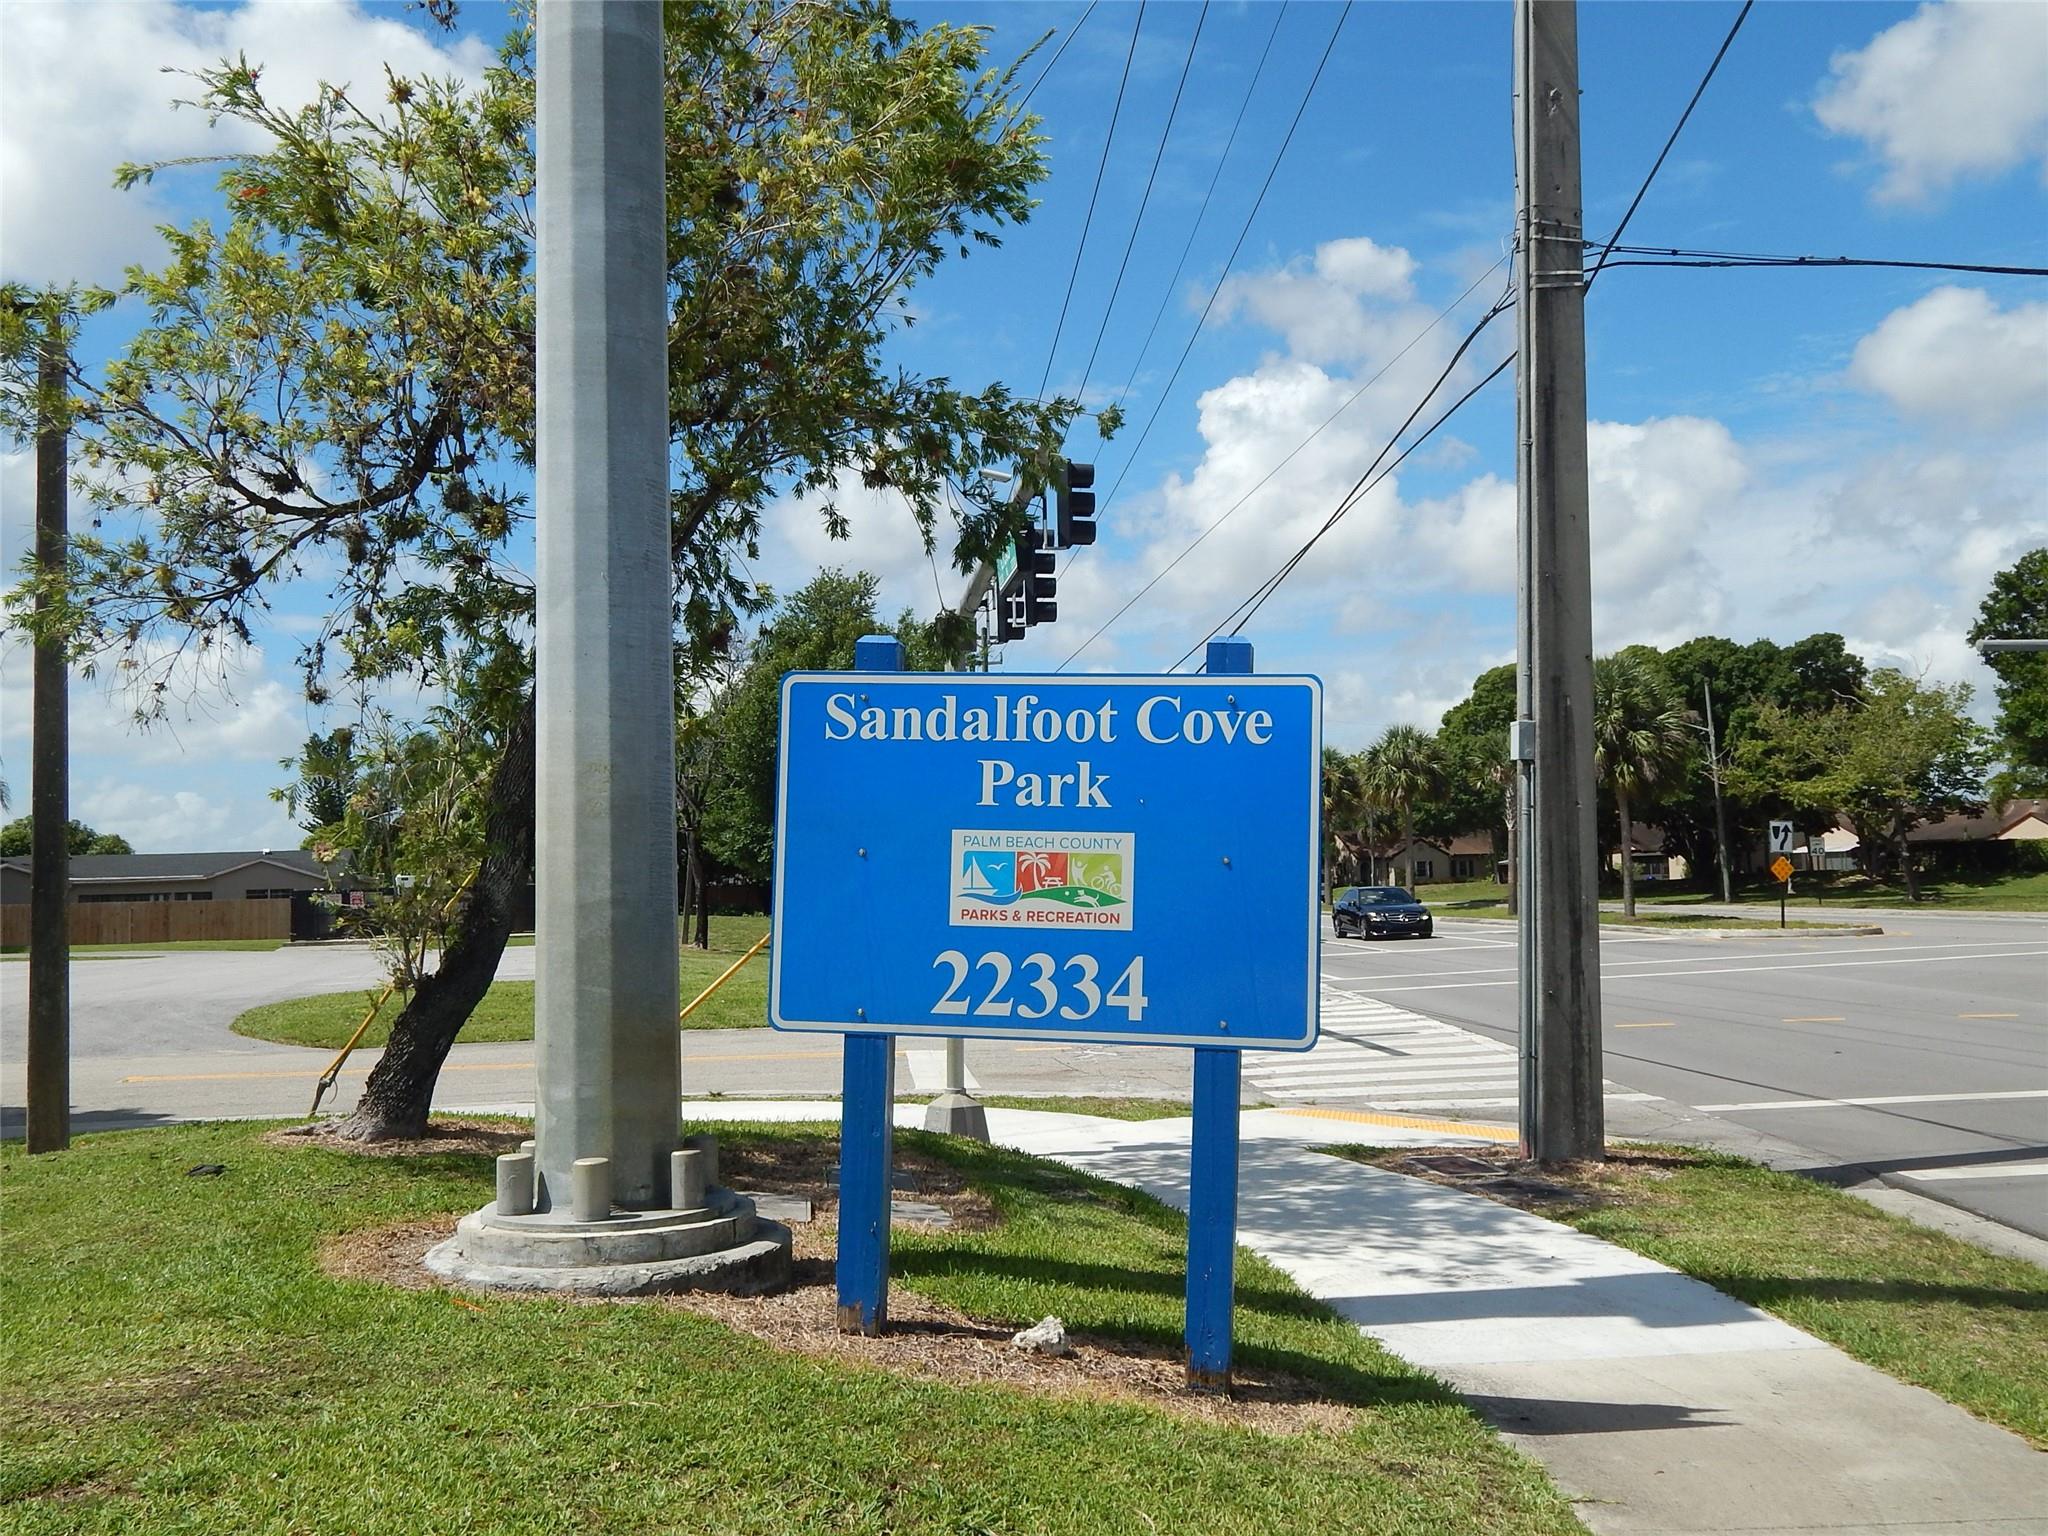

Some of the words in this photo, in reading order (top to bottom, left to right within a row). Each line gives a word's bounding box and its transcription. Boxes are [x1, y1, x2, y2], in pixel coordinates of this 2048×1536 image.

[825, 693, 1118, 744] Sandalfoot
[1136, 696, 1273, 745] Cove
[976, 760, 1112, 808] Park
[963, 835, 1001, 848] PALM
[1005, 836, 1055, 849] BEACH
[1059, 837, 1122, 850] COUNTY
[1811, 847, 1825, 855] 40
[961, 908, 1008, 922] PARKS
[1012, 910, 1022, 922] &
[1026, 910, 1120, 925] RECREATION
[930, 950, 1148, 1022] 22334
